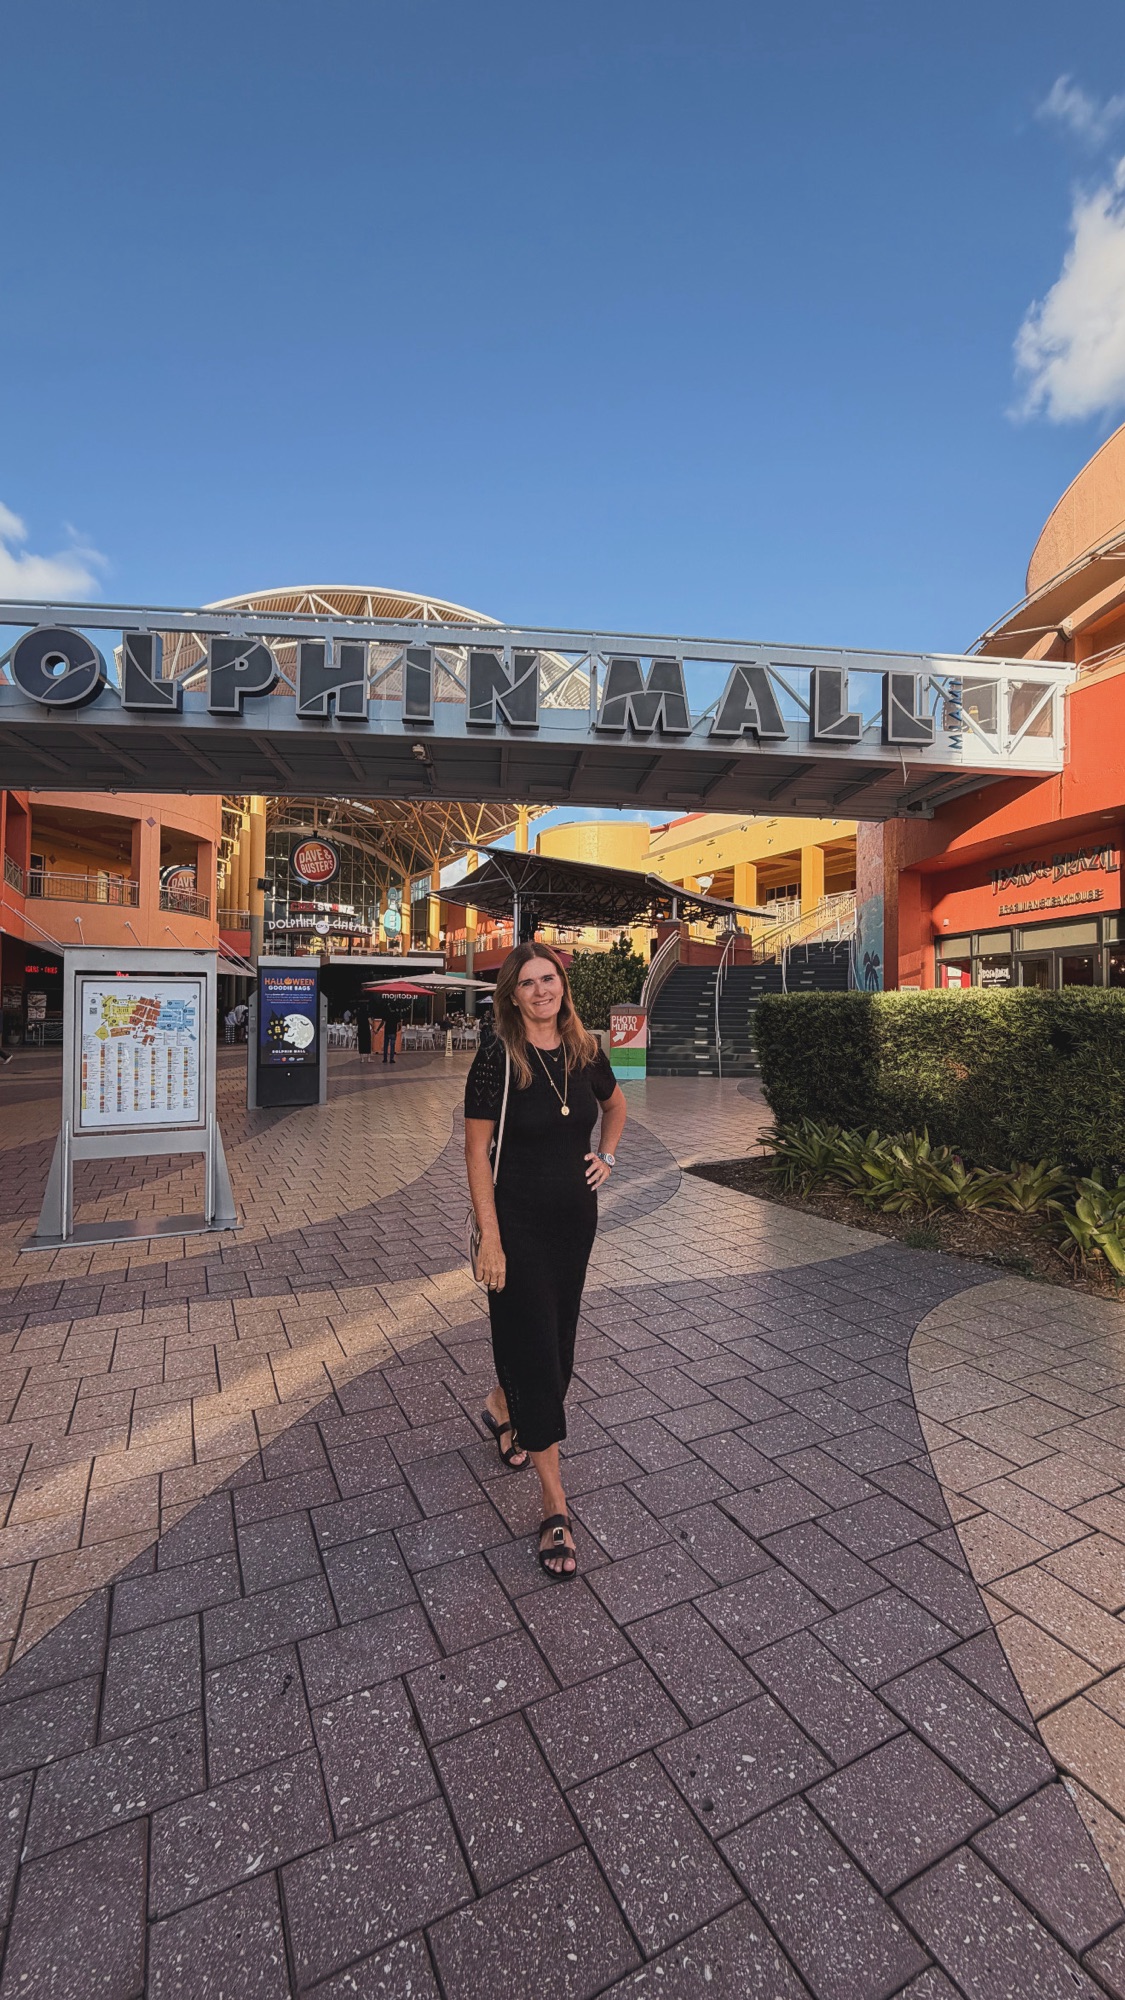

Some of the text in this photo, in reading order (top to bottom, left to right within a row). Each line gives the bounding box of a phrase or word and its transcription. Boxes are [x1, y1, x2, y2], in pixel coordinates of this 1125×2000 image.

[594, 656, 936, 746] MALL
[947, 680, 963, 750] MIAMI
[299, 849, 332, 864] DAVE &
[1052, 843, 1120, 884] BRAZIL
[300, 860, 333, 874] BUSTER'S
[268, 918, 315, 931] DOLPHIN
[264, 976, 315, 986] HALLOWEEN
[611, 1015, 638, 1024] PHOTO
[611, 1023, 639, 1032] MURAL
